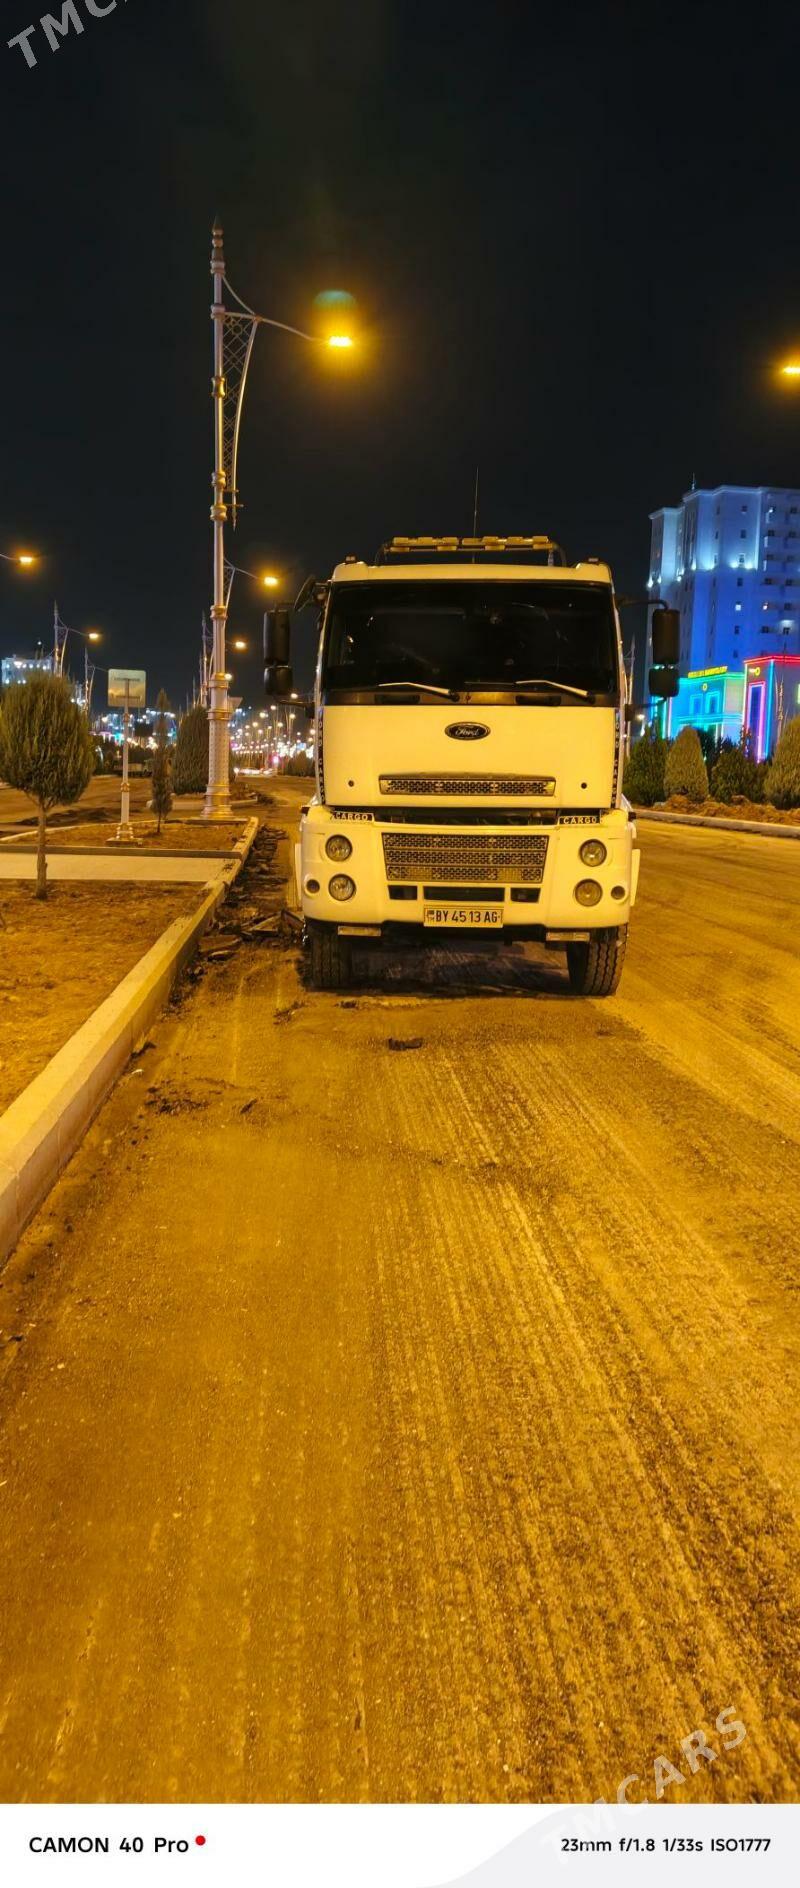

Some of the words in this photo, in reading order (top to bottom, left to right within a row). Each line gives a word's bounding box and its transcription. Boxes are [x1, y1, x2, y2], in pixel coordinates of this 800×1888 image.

[335, 811, 369, 821] CARGO
[563, 815, 597, 825] CARGO
[435, 910, 449, 922] BY
[483, 911, 498, 923] AG
